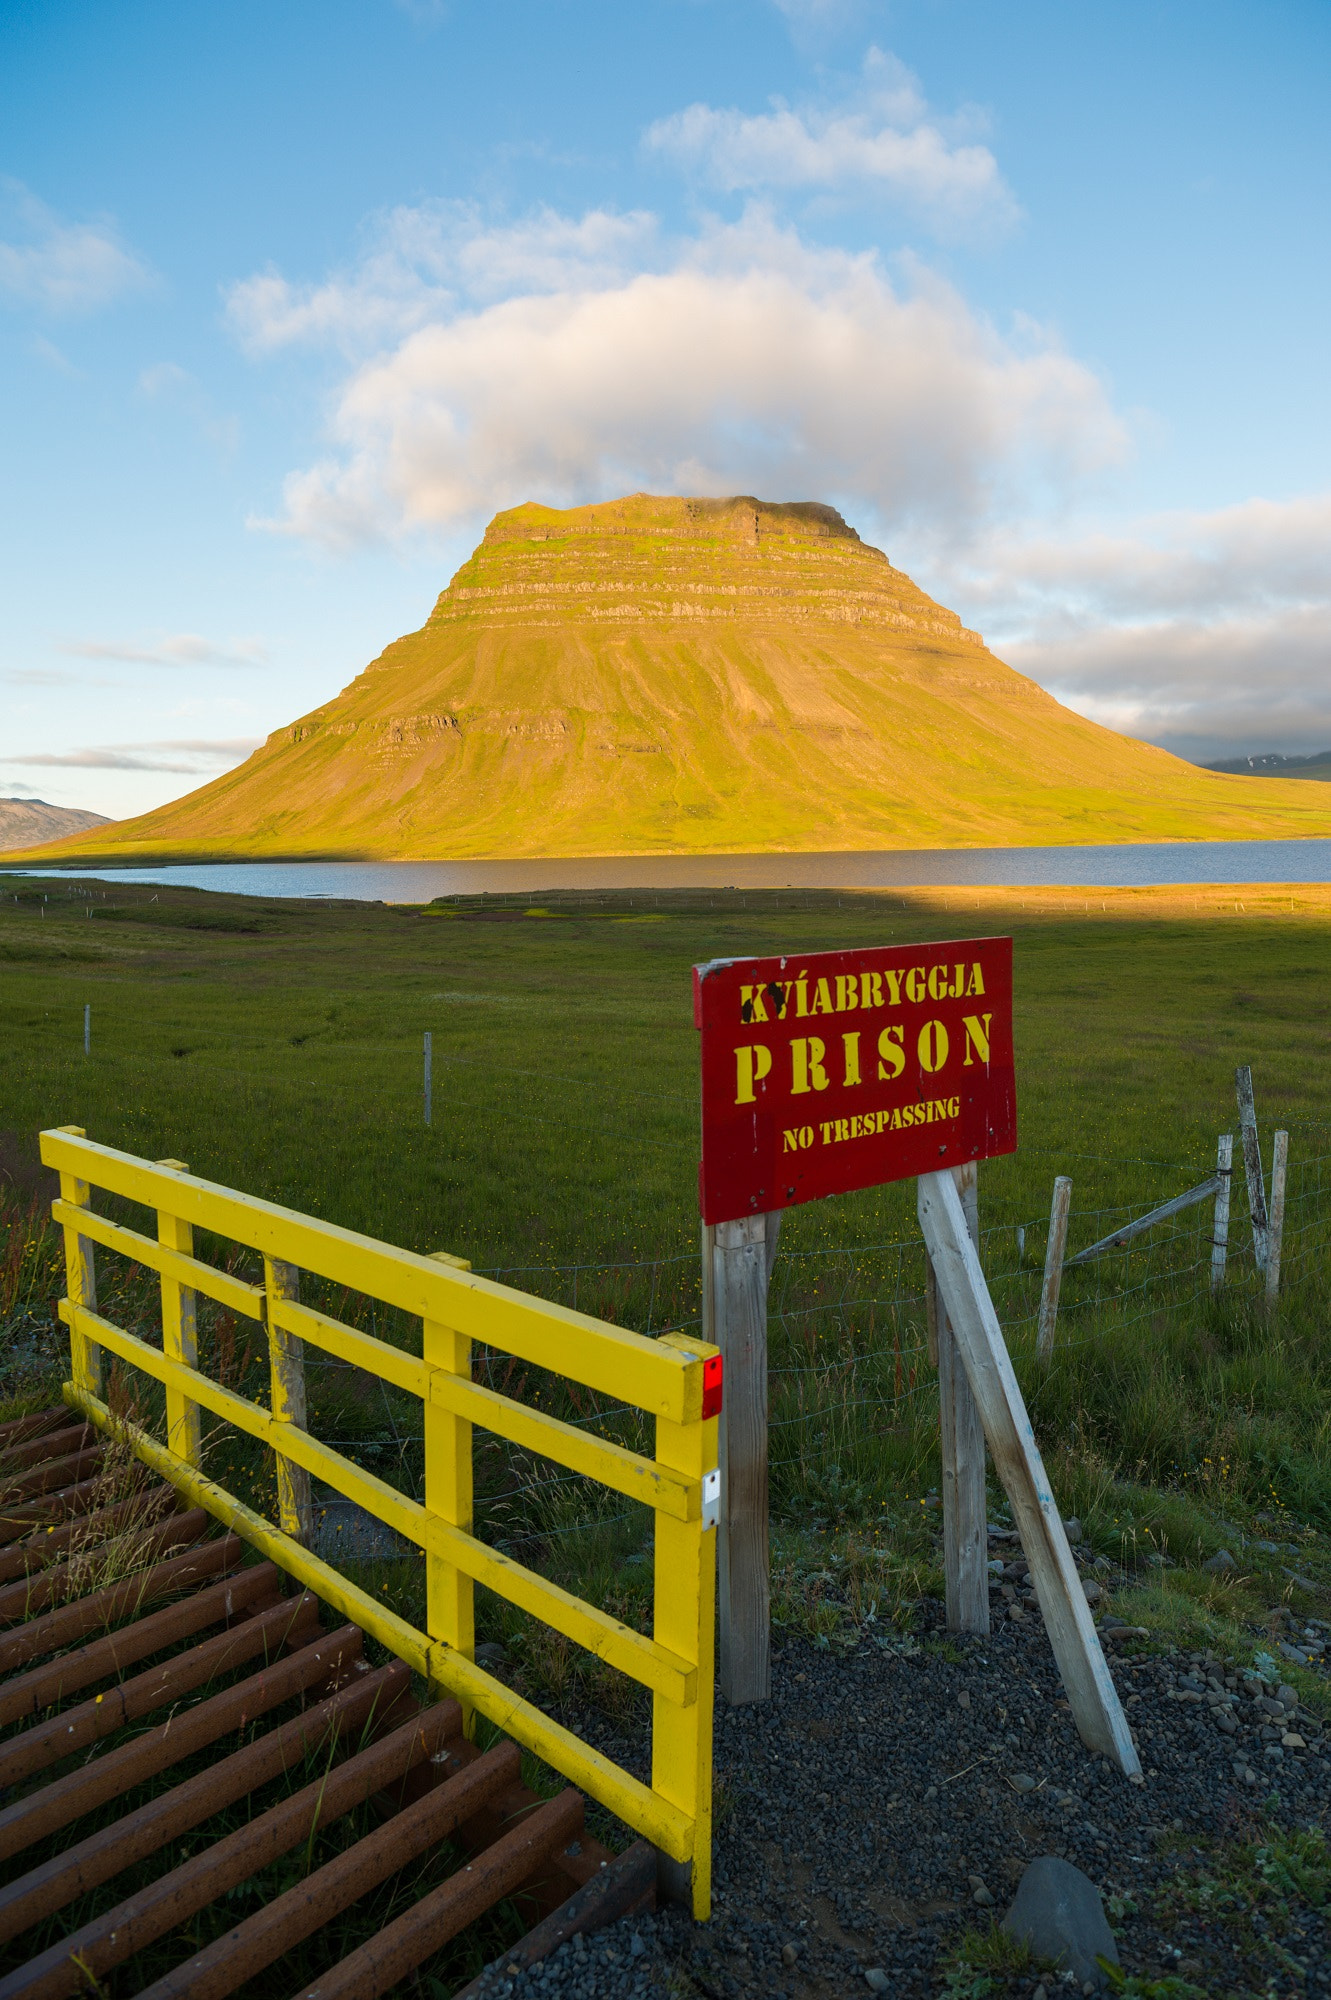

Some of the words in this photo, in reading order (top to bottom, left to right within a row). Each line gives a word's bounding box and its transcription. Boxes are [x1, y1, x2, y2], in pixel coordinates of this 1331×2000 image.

[733, 1013, 993, 1105] PRISON
[782, 1125, 815, 1153] NO
[819, 1096, 961, 1146] TRESPASSING
